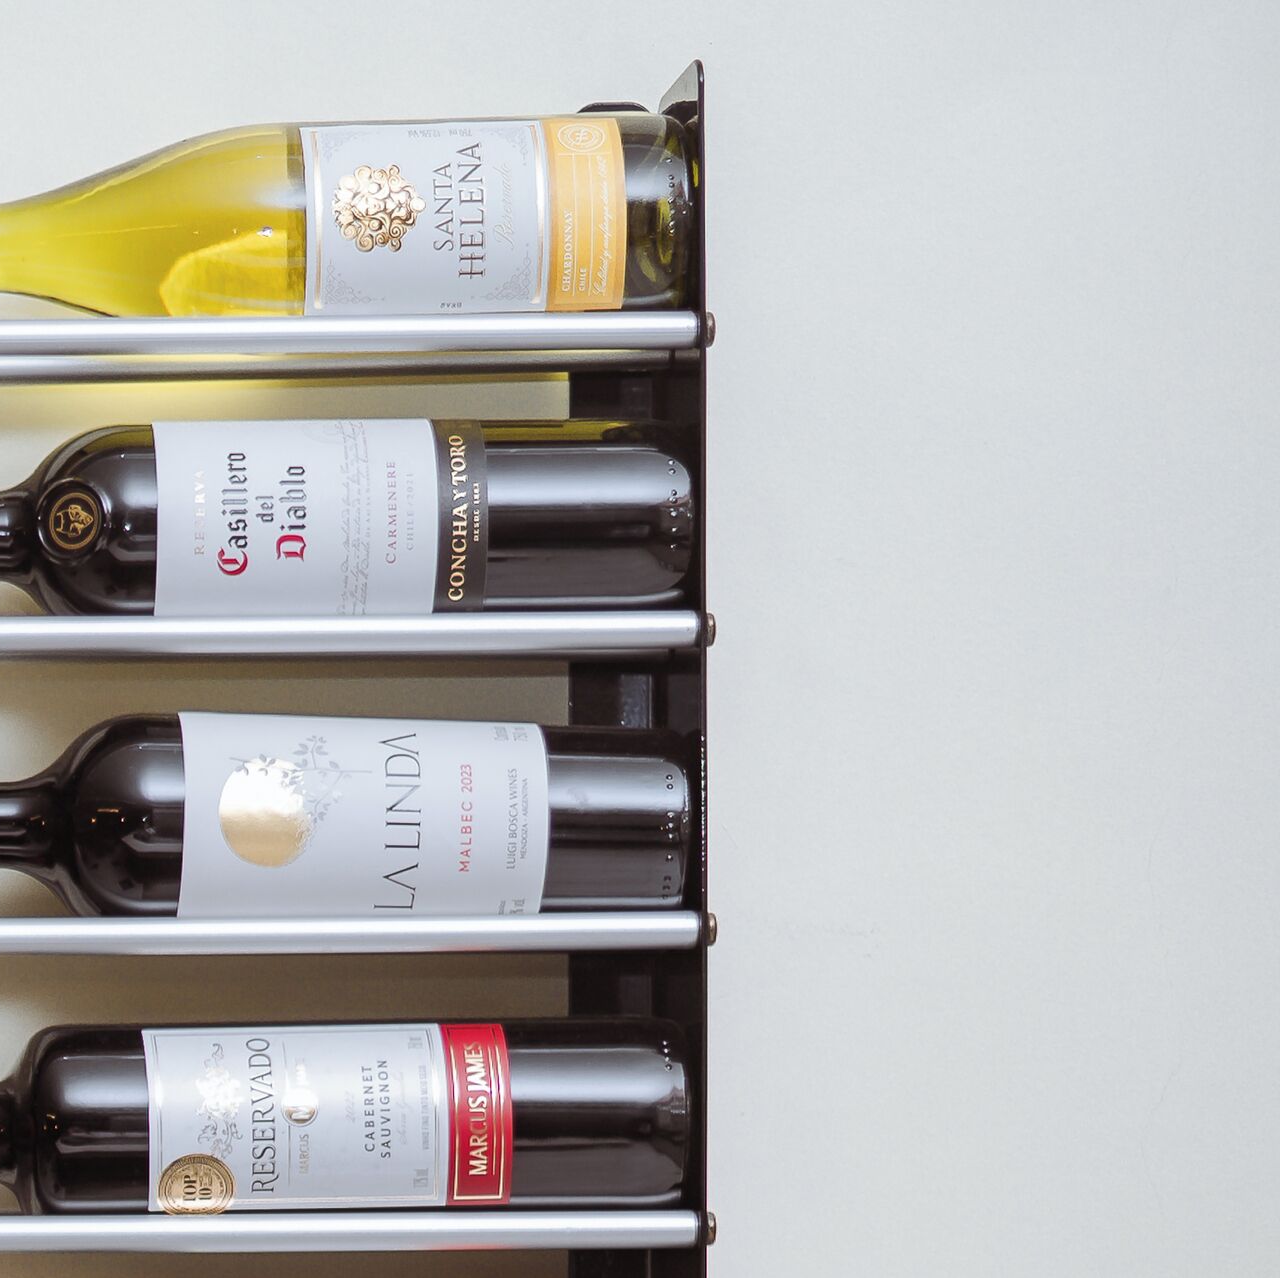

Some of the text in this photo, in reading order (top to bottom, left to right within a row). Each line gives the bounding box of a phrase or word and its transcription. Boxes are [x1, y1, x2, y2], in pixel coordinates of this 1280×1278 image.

[432, 161, 454, 252] SANTA
[456, 141, 485, 280] HELENA
[561, 208, 574, 292] CHARDONNAY
[578, 265, 587, 292] CHILE
[194, 467, 206, 555] RESERVA
[216, 451, 250, 576] Casillero
[255, 494, 274, 522] del
[276, 464, 308, 562] Diablo
[384, 460, 398, 564] CARMENERE
[447, 433, 470, 601] CONCHA Y TORO
[373, 731, 422, 911] LA LINDA
[458, 763, 473, 872] MALBEC 2023
[506, 767, 519, 870] LUIGI BOSCA WINES
[520, 777, 529, 860] MENDOZA ARGENTINA
[246, 1037, 278, 1193] RESERVADO
[298, 1133, 310, 1175] MARCUS
[362, 1065, 376, 1152] CABERNET
[376, 1059, 392, 1160] SAUVIGNON
[464, 1041, 490, 1176] MARCUS JAMES
[182, 1173, 198, 1202] TOP
[198, 1187, 213, 1201] 10
